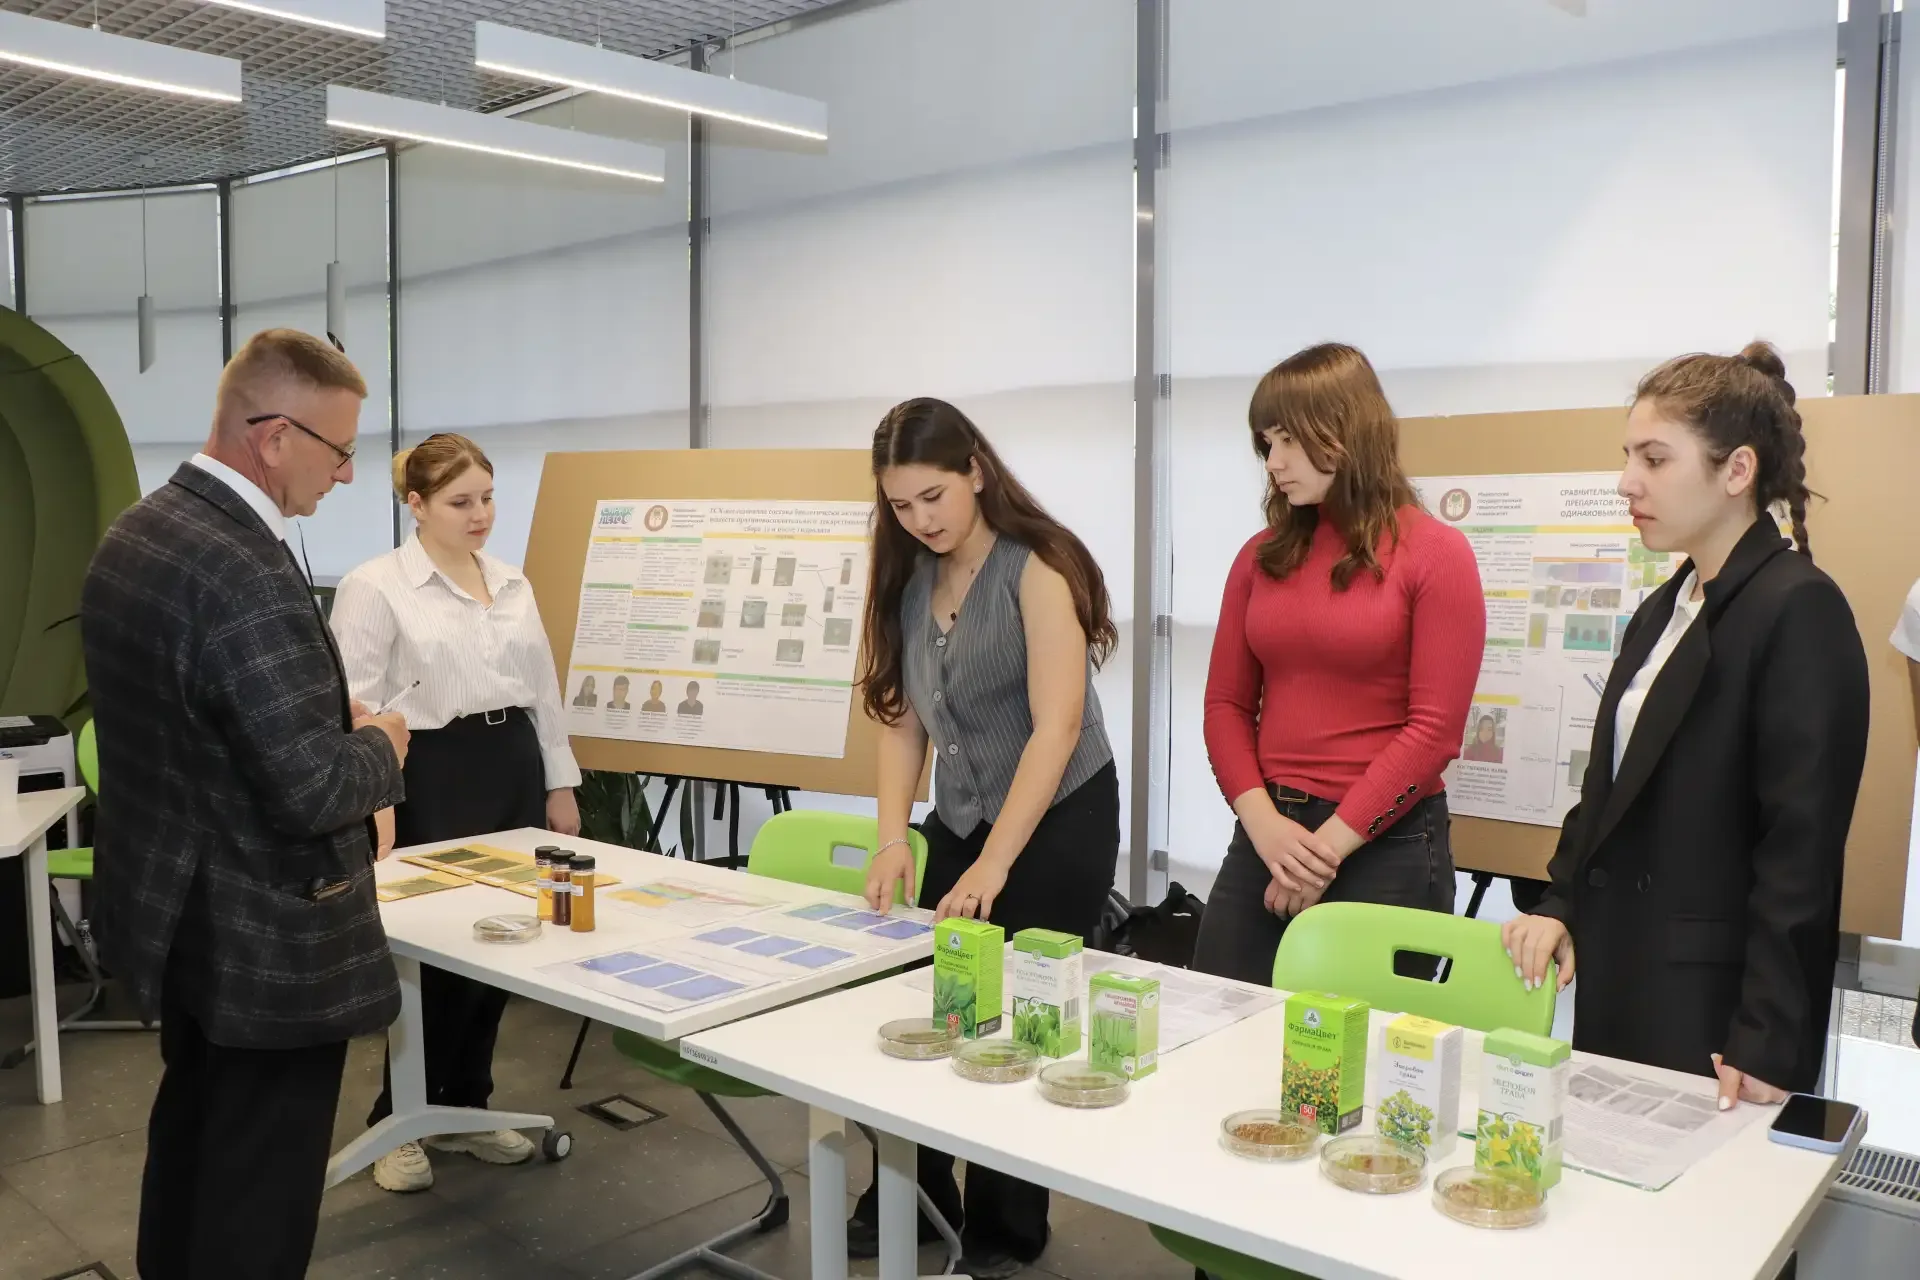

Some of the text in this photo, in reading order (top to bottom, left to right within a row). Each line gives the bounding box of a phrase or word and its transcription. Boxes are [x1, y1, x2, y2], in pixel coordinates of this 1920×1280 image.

[1565, 499, 1614, 507] ПРЕПАРАТОВ
[1560, 510, 1617, 518] ОДИНАКОВЫМ
[936, 944, 974, 960] ФармаЦвет
[1288, 1022, 1336, 1040] ФармаЦвет
[1500, 1086, 1526, 1100] ТРАВА
